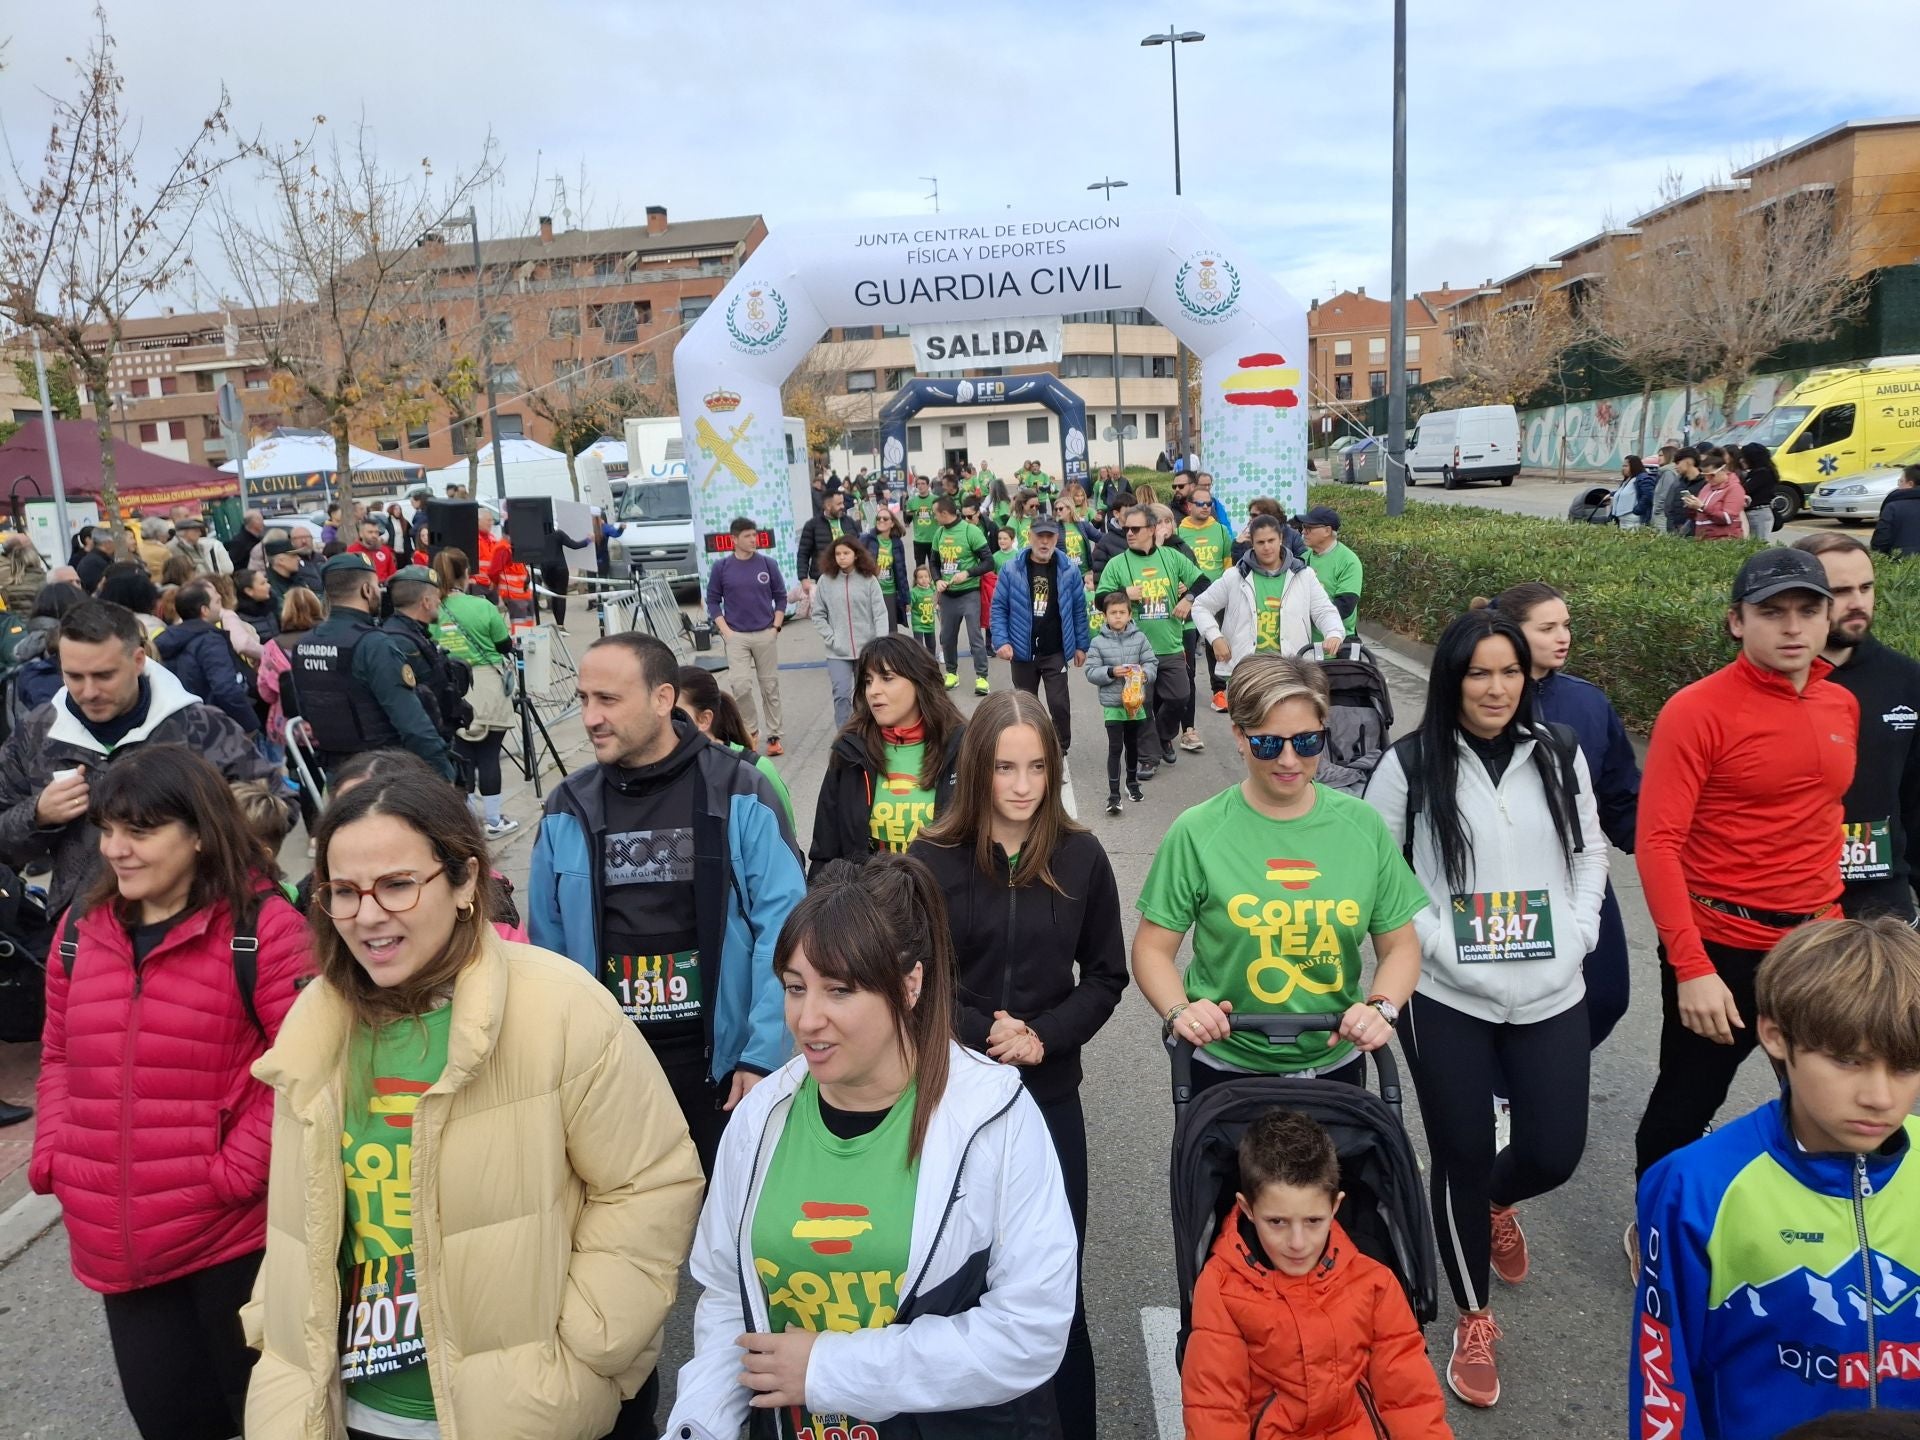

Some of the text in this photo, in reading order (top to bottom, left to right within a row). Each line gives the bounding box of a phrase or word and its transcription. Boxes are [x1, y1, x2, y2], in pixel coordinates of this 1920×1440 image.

[855, 215, 1120, 247] JUNTA CENTRAL DE EDUCACIÓN
[907, 239, 1066, 264] FÍSICA Y DEPORTES
[854, 263, 1122, 306] GUARDIA CIVIL
[1181, 304, 1240, 326] GUARDIA CIVIL
[729, 335, 788, 356] GUARDIA CIVIL
[926, 329, 1049, 360] SALIDA
[977, 381, 1005, 396] FFD
[1876, 383, 1920, 396] AMBULA
[1898, 407, 1910, 417] La
[352, 468, 407, 484] GUARDIA CIVIL
[1065, 460, 1088, 473] FFD
[250, 481, 259, 494] A
[262, 475, 302, 492] CIVIL
[1142, 602, 1167, 614] 1146
[297, 644, 338, 658] GUARDIA
[303, 658, 329, 672] CIVIL
[873, 801, 936, 822] orr
[1848, 863, 1890, 873] SOLIDARIA
[1227, 893, 1360, 929] Corre
[1469, 913, 1539, 943] 1347
[1249, 924, 1341, 958] TEA
[1464, 940, 1553, 953] CARRERA SOLIDARIA
[1464, 953, 1504, 961] GUARDIA
[618, 975, 689, 1005] 1319
[650, 1000, 701, 1012] SOLIDARIA
[346, 1292, 419, 1349] 1207
[368, 1338, 428, 1361] SOLIDA
[366, 1359, 402, 1376] CIVIL
[408, 1354, 421, 1365] LA
[815, 1413, 848, 1425] MARIA
